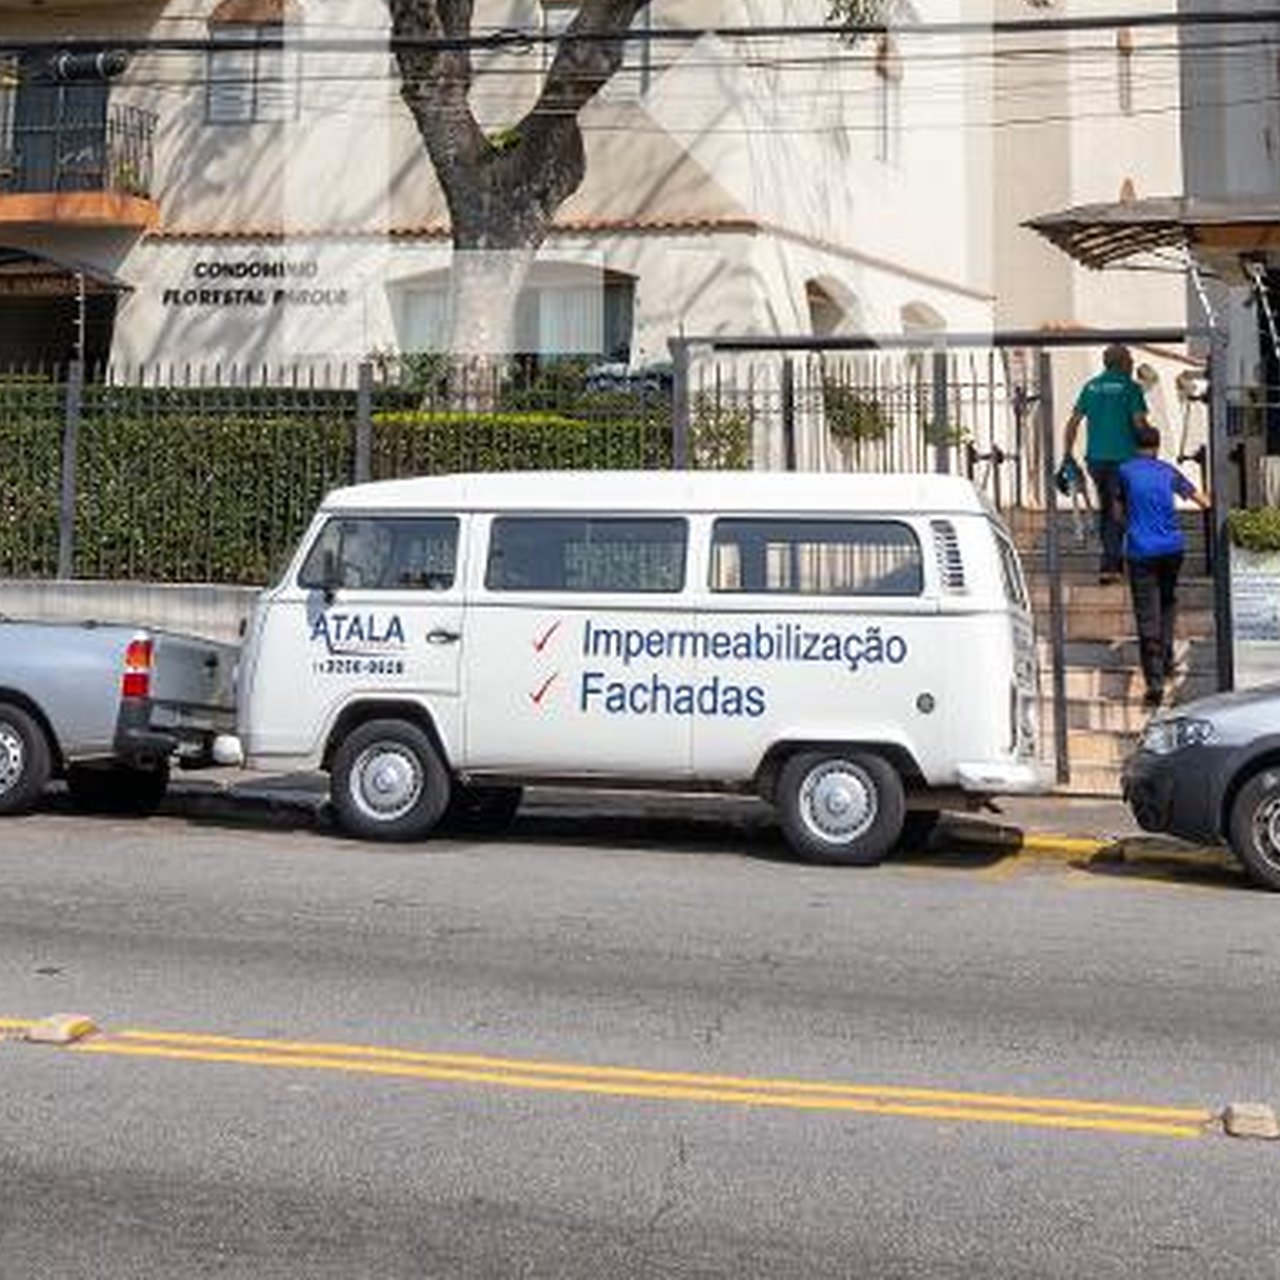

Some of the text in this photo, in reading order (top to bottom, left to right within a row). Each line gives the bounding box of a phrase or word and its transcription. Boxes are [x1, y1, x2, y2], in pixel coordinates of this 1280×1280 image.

[162, 289, 266, 307] FLORESTAL
[310, 612, 405, 643] ATALA
[581, 619, 908, 672] Impermeabilização
[580, 671, 767, 717] Fachadas
